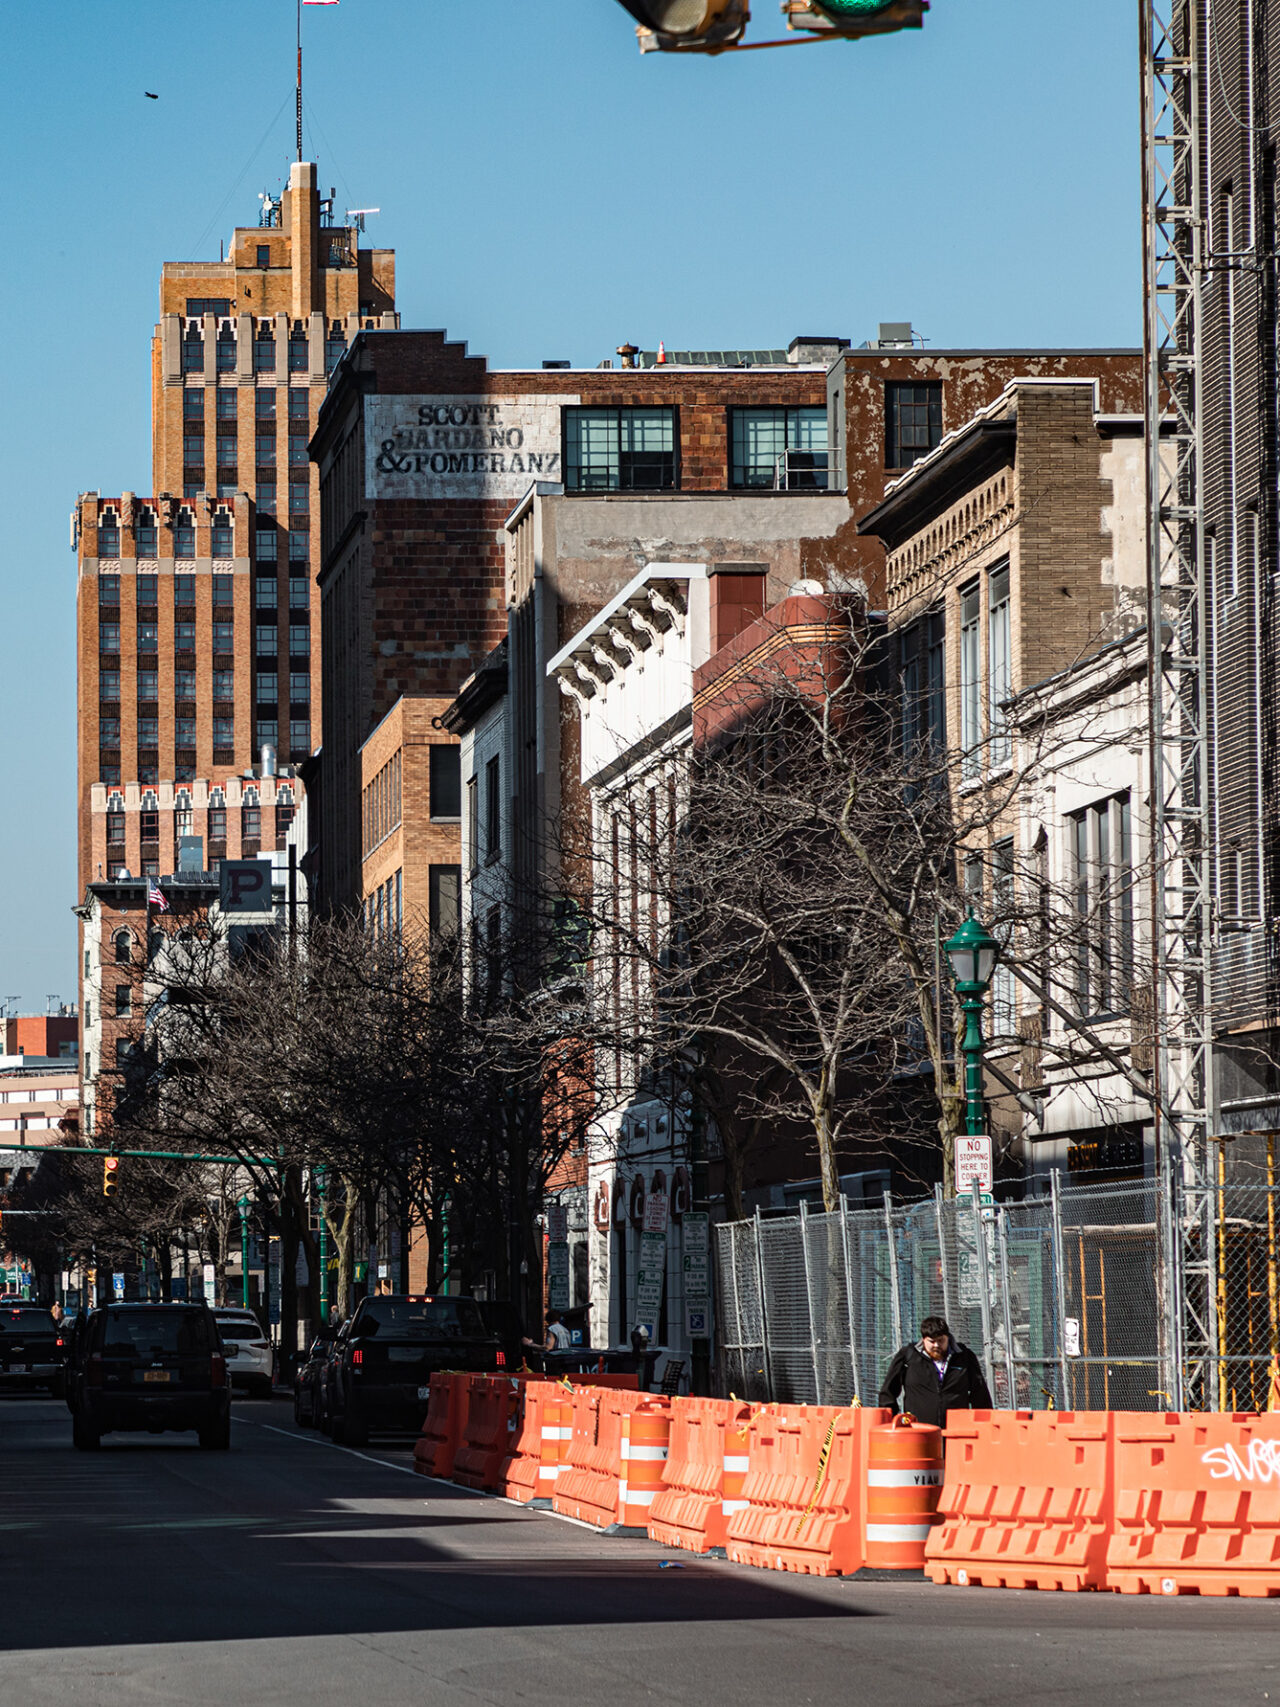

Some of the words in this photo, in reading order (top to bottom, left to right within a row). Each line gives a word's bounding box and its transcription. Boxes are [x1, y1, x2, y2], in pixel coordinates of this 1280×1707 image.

[376, 439, 412, 473] &
[414, 452, 561, 474] POMERANZ
[228, 868, 263, 905] P
[967, 1140, 981, 1152] NO
[960, 1153, 989, 1161] STOPPING
[961, 1163, 977, 1171] HERE
[980, 1163, 988, 1171] TO
[961, 1173, 989, 1181] CORNER
[572, 1330, 581, 1342] P
